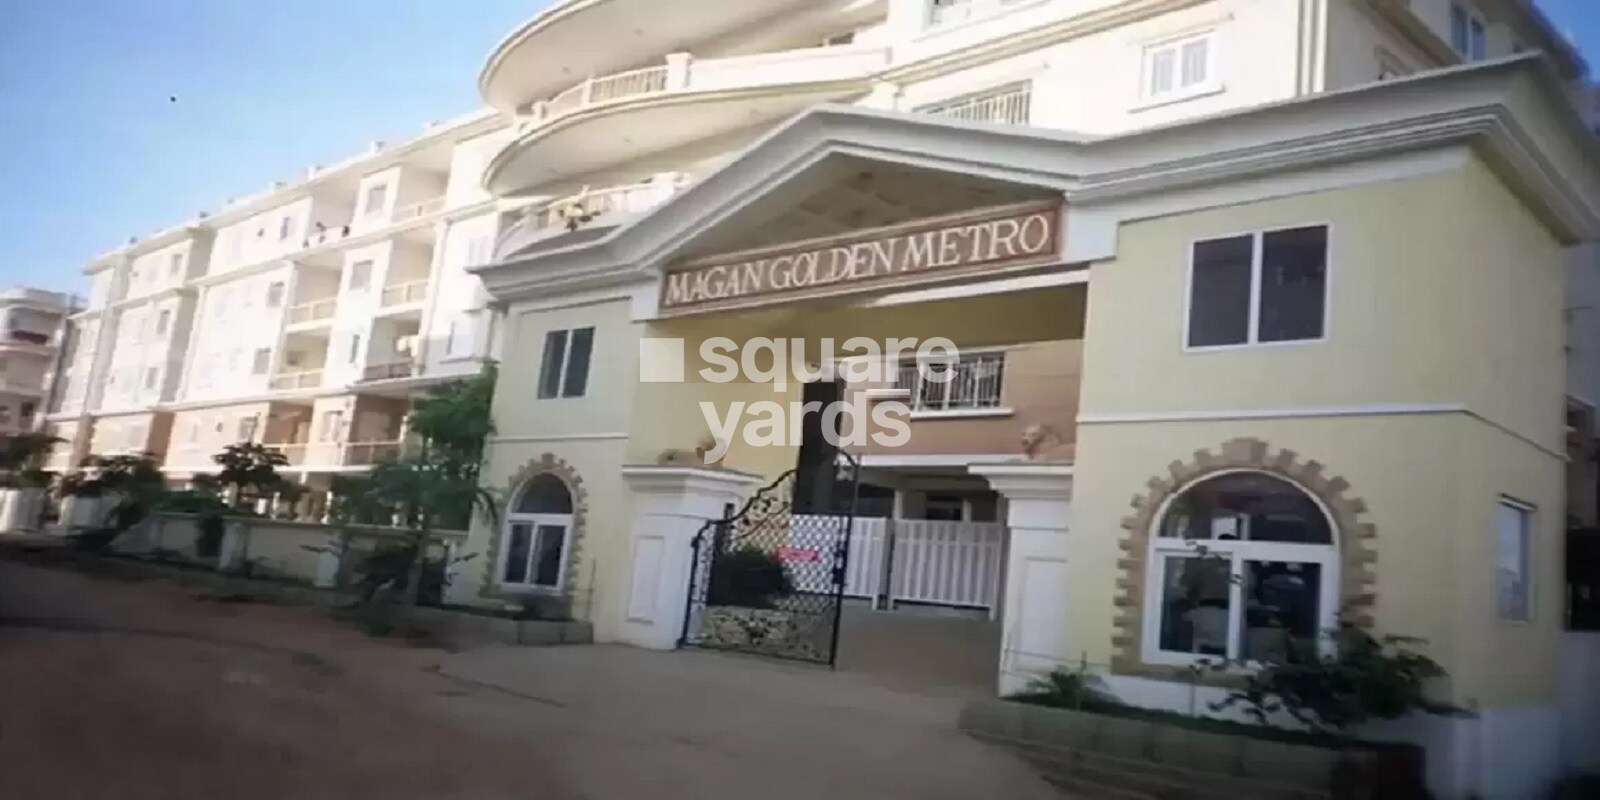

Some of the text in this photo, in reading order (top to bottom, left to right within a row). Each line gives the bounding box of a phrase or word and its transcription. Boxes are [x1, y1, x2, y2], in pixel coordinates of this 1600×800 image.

[665, 215, 1048, 305] MAGAN GOLDEN METRO
